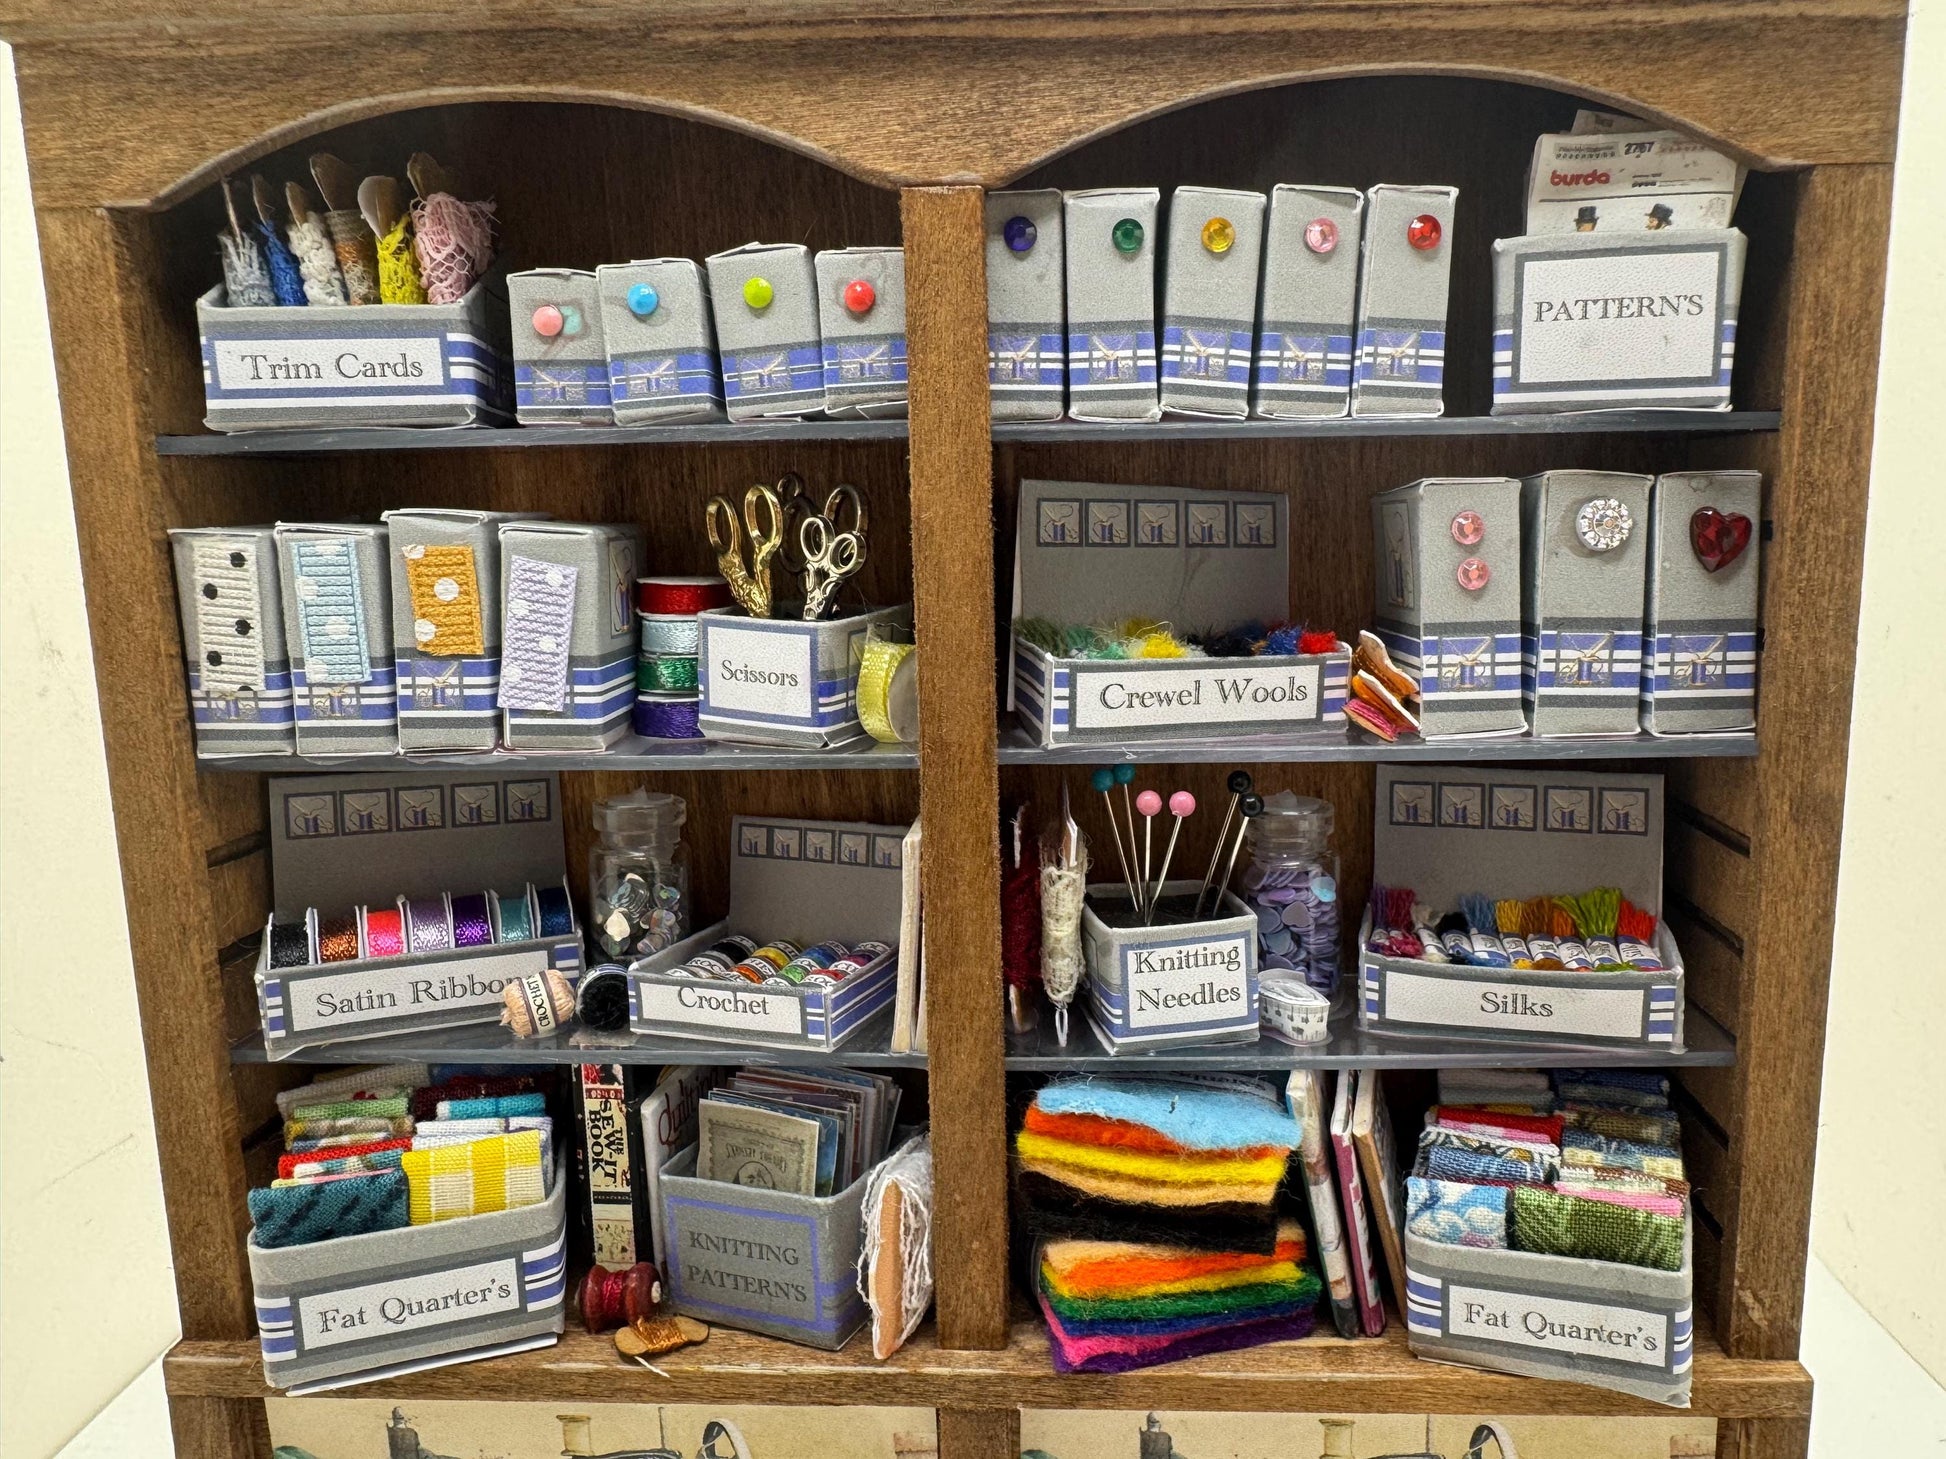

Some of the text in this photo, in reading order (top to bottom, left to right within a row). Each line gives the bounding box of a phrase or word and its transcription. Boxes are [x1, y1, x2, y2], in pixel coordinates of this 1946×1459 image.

[1550, 169, 1610, 186] burda
[1533, 294, 1703, 323] PATTERN'S
[241, 353, 423, 380] Trim Cards
[721, 659, 798, 687] Scissors
[1100, 676, 1307, 709] Crewel Wools
[1134, 946, 1240, 974] Knitting
[316, 989, 396, 1017] Satin
[526, 979, 550, 1027] CROCHET
[677, 986, 769, 1015] Crochet
[1136, 982, 1240, 1011] Needles
[1480, 991, 1553, 1017] Silks
[589, 1109, 605, 1172] BOOK
[600, 1099, 617, 1184] SEW-IT
[689, 1231, 800, 1266] KNITTING
[688, 1266, 807, 1302] PATTERN'S
[318, 1278, 511, 1334] Fat Quarter's
[1464, 1303, 1658, 1351] Fat Quarter's
